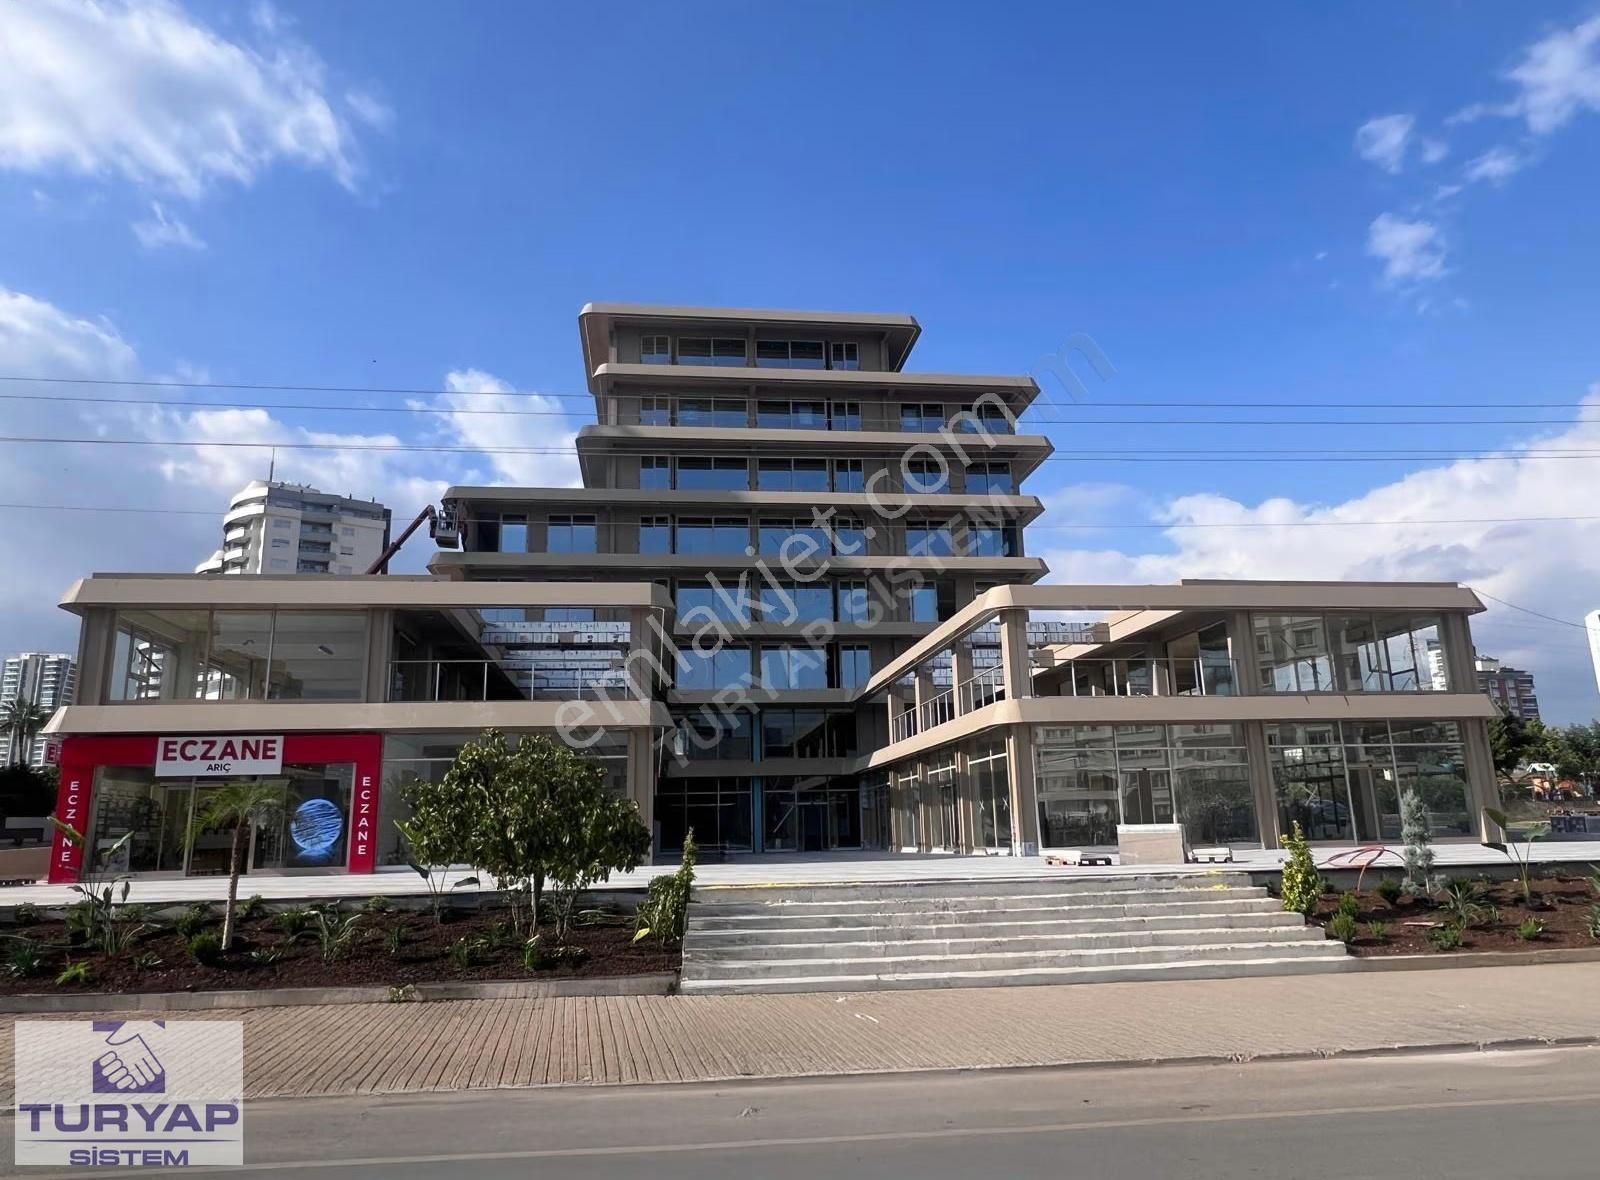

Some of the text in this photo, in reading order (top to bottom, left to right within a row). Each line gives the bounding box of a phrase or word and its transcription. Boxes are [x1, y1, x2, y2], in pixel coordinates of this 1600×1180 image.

[162, 739, 277, 762] ECZANE
[206, 763, 231, 774] ARIÇ
[357, 776, 371, 855] ECZANE
